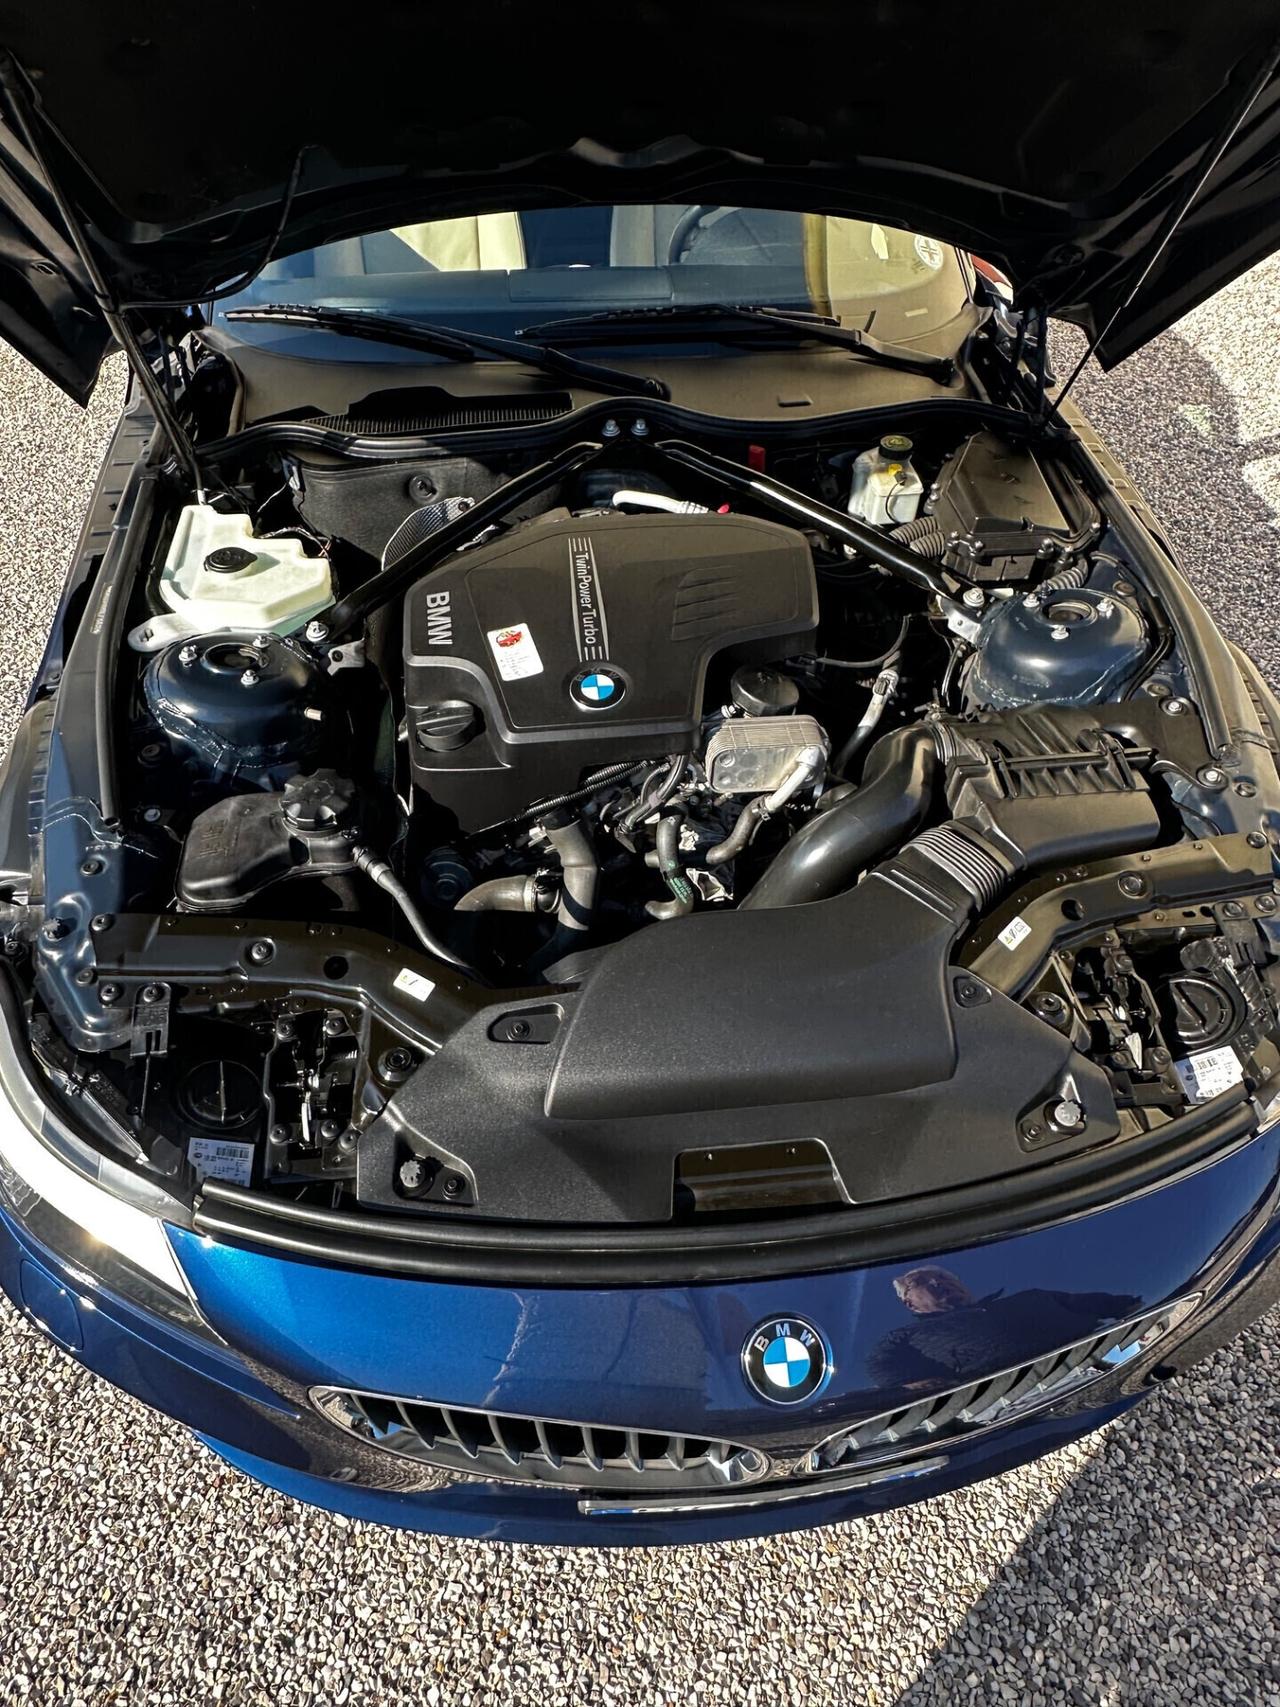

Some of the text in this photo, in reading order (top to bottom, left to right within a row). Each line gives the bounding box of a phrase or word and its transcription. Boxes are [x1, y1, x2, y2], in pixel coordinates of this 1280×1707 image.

[426, 591, 453, 645] BMW
[576, 552, 599, 644] TwinPower Turbo
[754, 1322, 816, 1352] BMW
